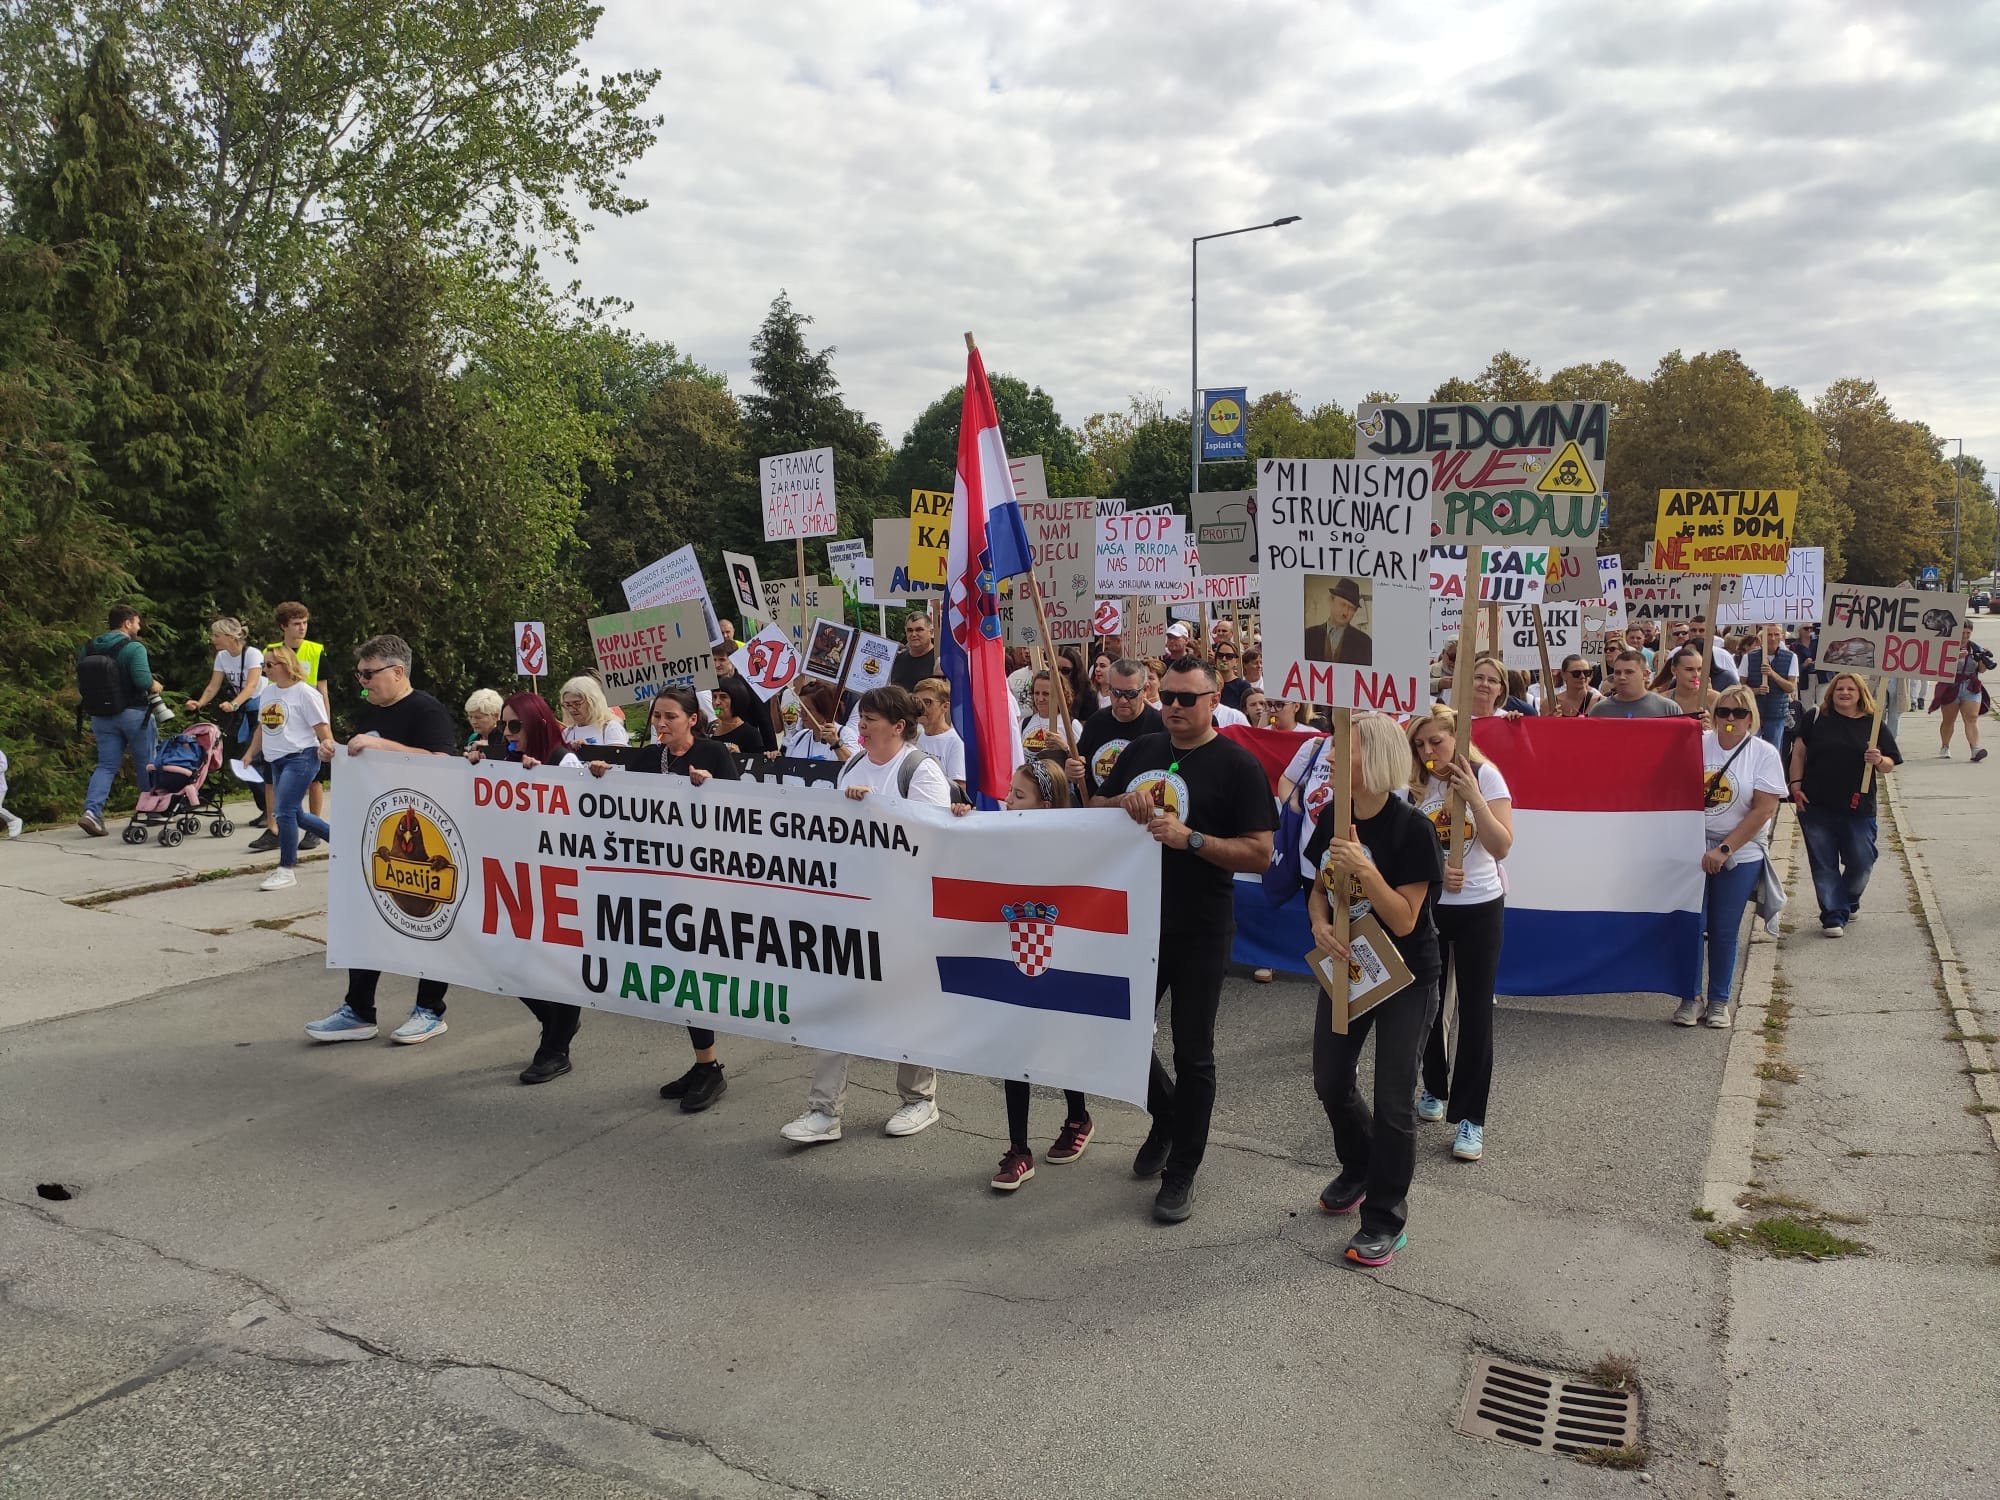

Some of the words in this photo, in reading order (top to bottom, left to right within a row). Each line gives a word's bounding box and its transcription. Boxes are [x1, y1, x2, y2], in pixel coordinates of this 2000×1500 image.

[1205, 441, 1231, 451] Isplati
[770, 454, 824, 478] STRANAC
[1333, 463, 1429, 501] NISMO
[768, 491, 825, 518] APATIJA
[1272, 495, 1412, 535] STRUČNJACI
[1665, 491, 1779, 516] APATIJA
[767, 519, 795, 537] GUTA
[802, 513, 836, 534] SMRAD
[1039, 523, 1070, 540] NAM
[1105, 516, 1171, 541] STOP
[1202, 528, 1240, 541] PROFIT
[1299, 530, 1314, 542] MI
[1331, 530, 1365, 543] SMO
[1676, 521, 1695, 537] je
[1698, 520, 1724, 537] naš
[1733, 517, 1784, 539] DOM
[1135, 542, 1178, 555] PRIRODA
[1655, 537, 1692, 570] NE
[1138, 557, 1166, 572] DOM
[1205, 576, 1247, 598] PROFIT
[1622, 573, 1665, 586] Mandati
[1763, 601, 1774, 620] U
[1784, 599, 1814, 620] HR
[1828, 594, 1920, 633] FARME
[596, 625, 667, 655] KUPUJETE
[1050, 619, 1094, 641] BRIGA
[600, 645, 667, 671] TRUJETE
[1882, 634, 1960, 678] BOLE
[605, 664, 657, 689] PRLJAVI
[662, 654, 711, 678] PROFIT
[1281, 661, 1334, 705] AM
[1353, 669, 1417, 713] NAJ
[370, 801, 388, 827] STOP
[392, 794, 420, 807] FARMI
[423, 801, 452, 838] PILIĆA
[474, 777, 570, 815] DOSTA
[578, 793, 684, 827] ODLUKA
[691, 803, 707, 829] U
[714, 805, 763, 836] IME
[769, 811, 919, 856] GRAĐANA,
[538, 830, 554, 855] A
[559, 832, 596, 859] NA
[604, 831, 684, 868] ŠTETU
[690, 847, 837, 888] GRAĐANA!
[385, 863, 441, 893] Apatija
[382, 899, 399, 920] SELO
[482, 857, 583, 947] NE
[597, 894, 883, 981] MEGAFARMI
[581, 954, 608, 993] U
[620, 961, 791, 1025] APATIJI!
